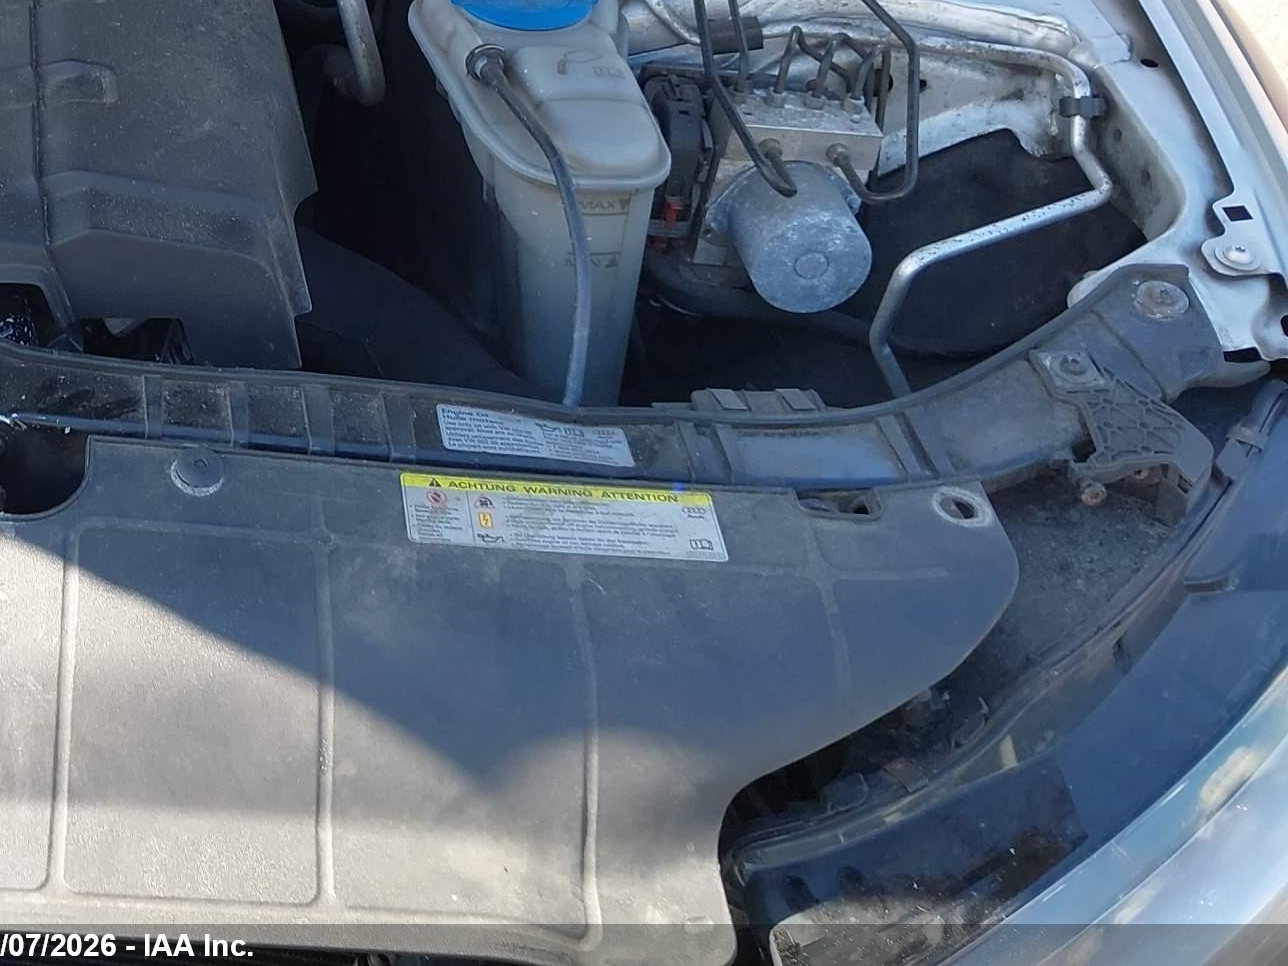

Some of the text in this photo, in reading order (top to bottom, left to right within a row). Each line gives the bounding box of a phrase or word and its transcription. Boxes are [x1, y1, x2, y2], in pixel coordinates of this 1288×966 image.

[448, 480, 679, 503] ACHTUNG WARNING ATTENTION
